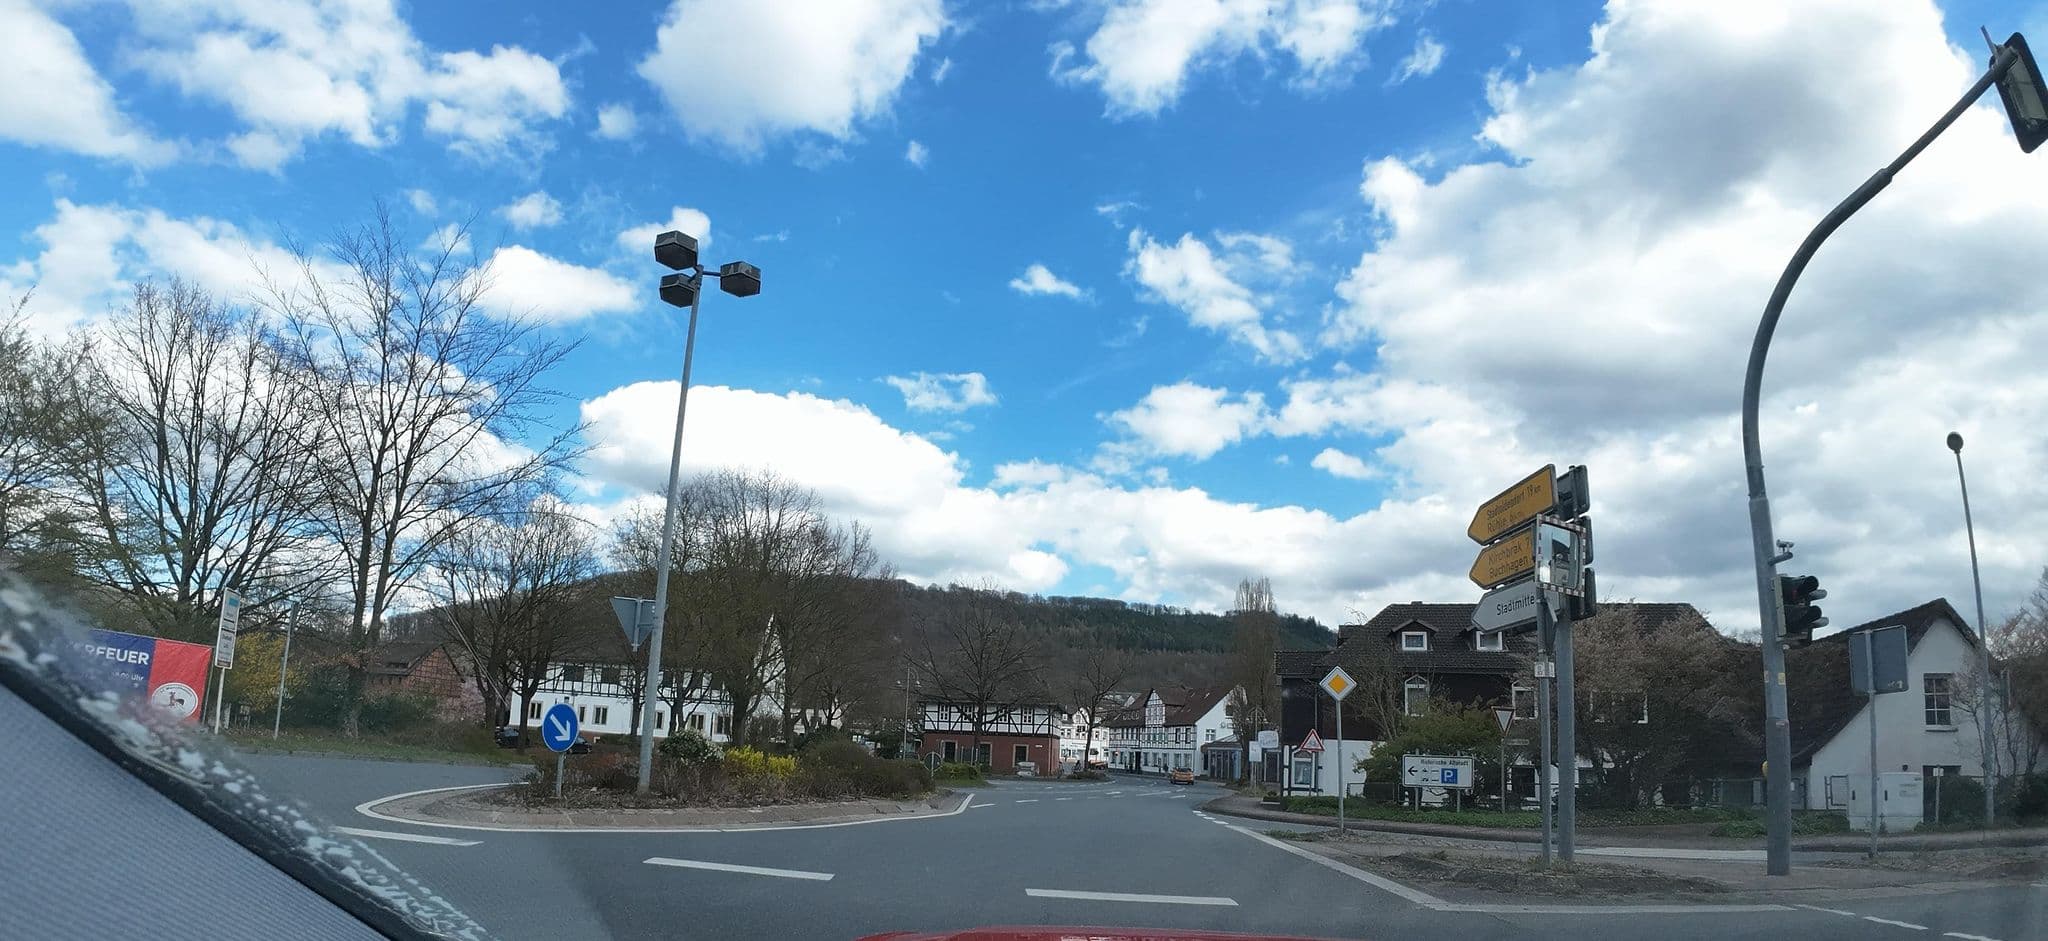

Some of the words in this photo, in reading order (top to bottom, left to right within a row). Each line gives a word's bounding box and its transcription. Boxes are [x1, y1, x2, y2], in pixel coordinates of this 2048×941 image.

[1488, 543, 1522, 563] Kirchbrak
[1488, 557, 1528, 577] Buchhagen
[1496, 593, 1535, 615] Stadtmitte
[130, 672, 144, 681] Uhr
[1444, 770, 1454, 782] P
